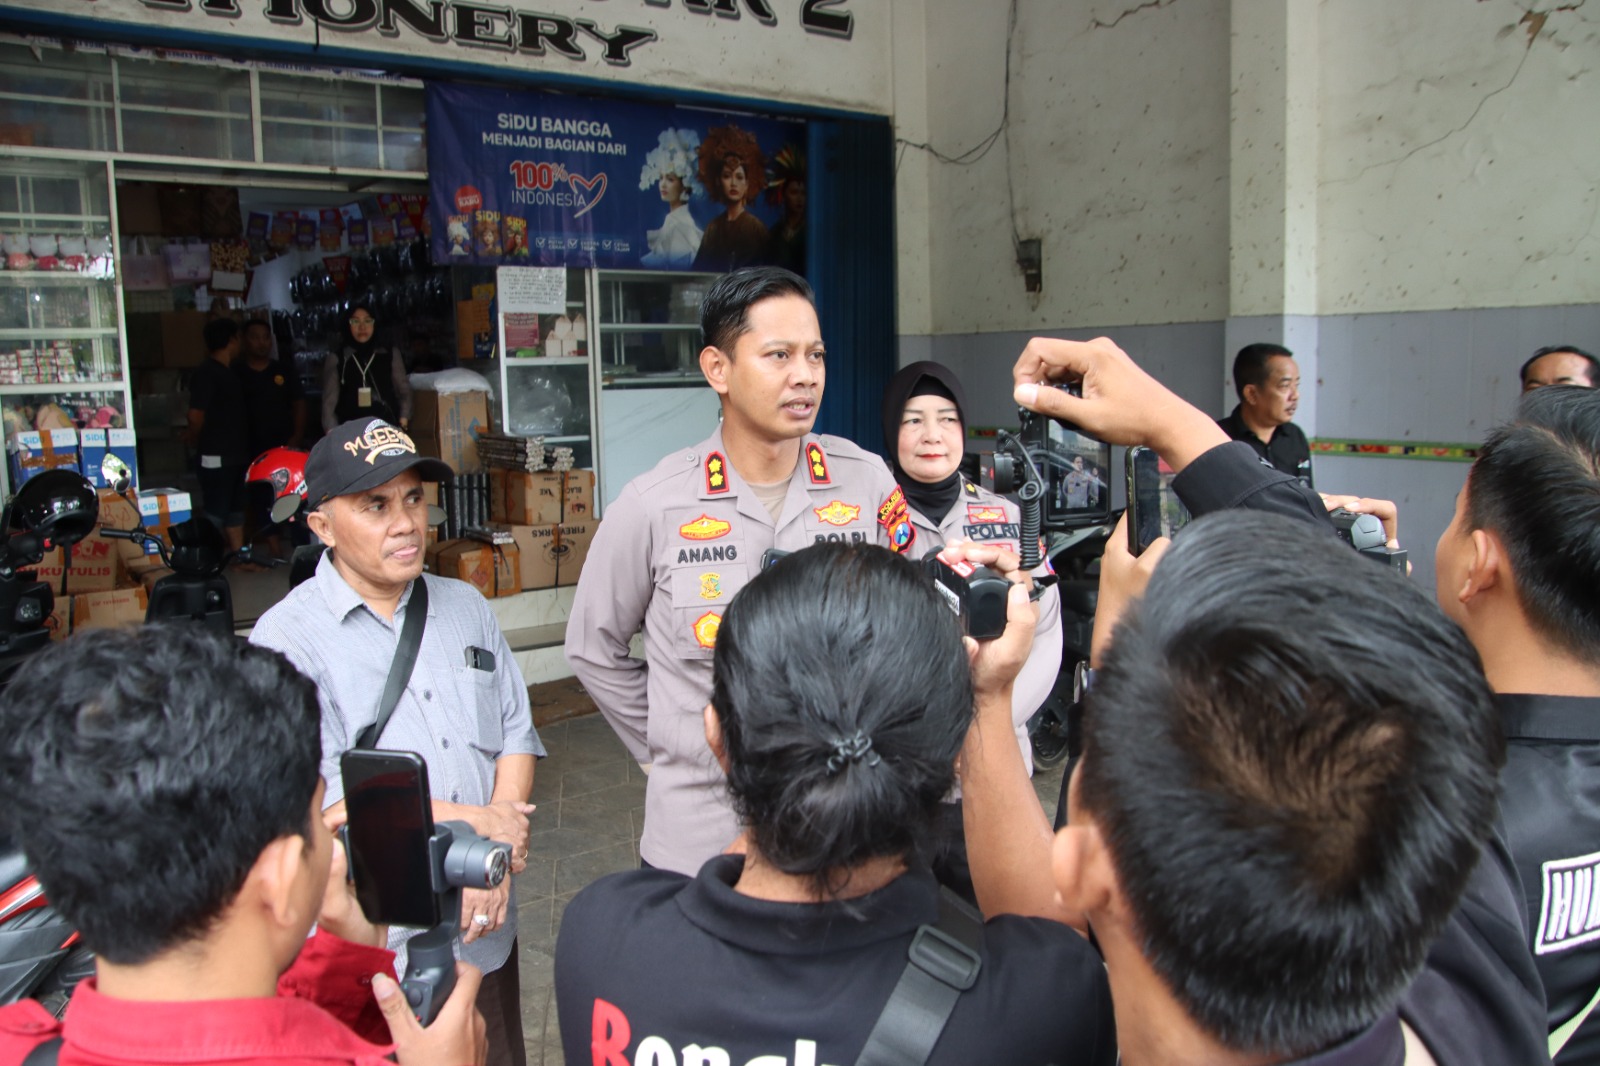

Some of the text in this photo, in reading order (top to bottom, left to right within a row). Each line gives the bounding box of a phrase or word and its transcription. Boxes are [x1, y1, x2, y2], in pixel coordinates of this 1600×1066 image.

[497, 112, 613, 138] SiDU BANGGA
[482, 132, 627, 156] MENJADI BAGIAN DARI
[510, 160, 569, 190] 100%
[511, 190, 587, 207] INDONESIA
[968, 524, 1019, 539] POLRI
[677, 545, 738, 564] ANANG
[68, 567, 111, 576] TULIS
